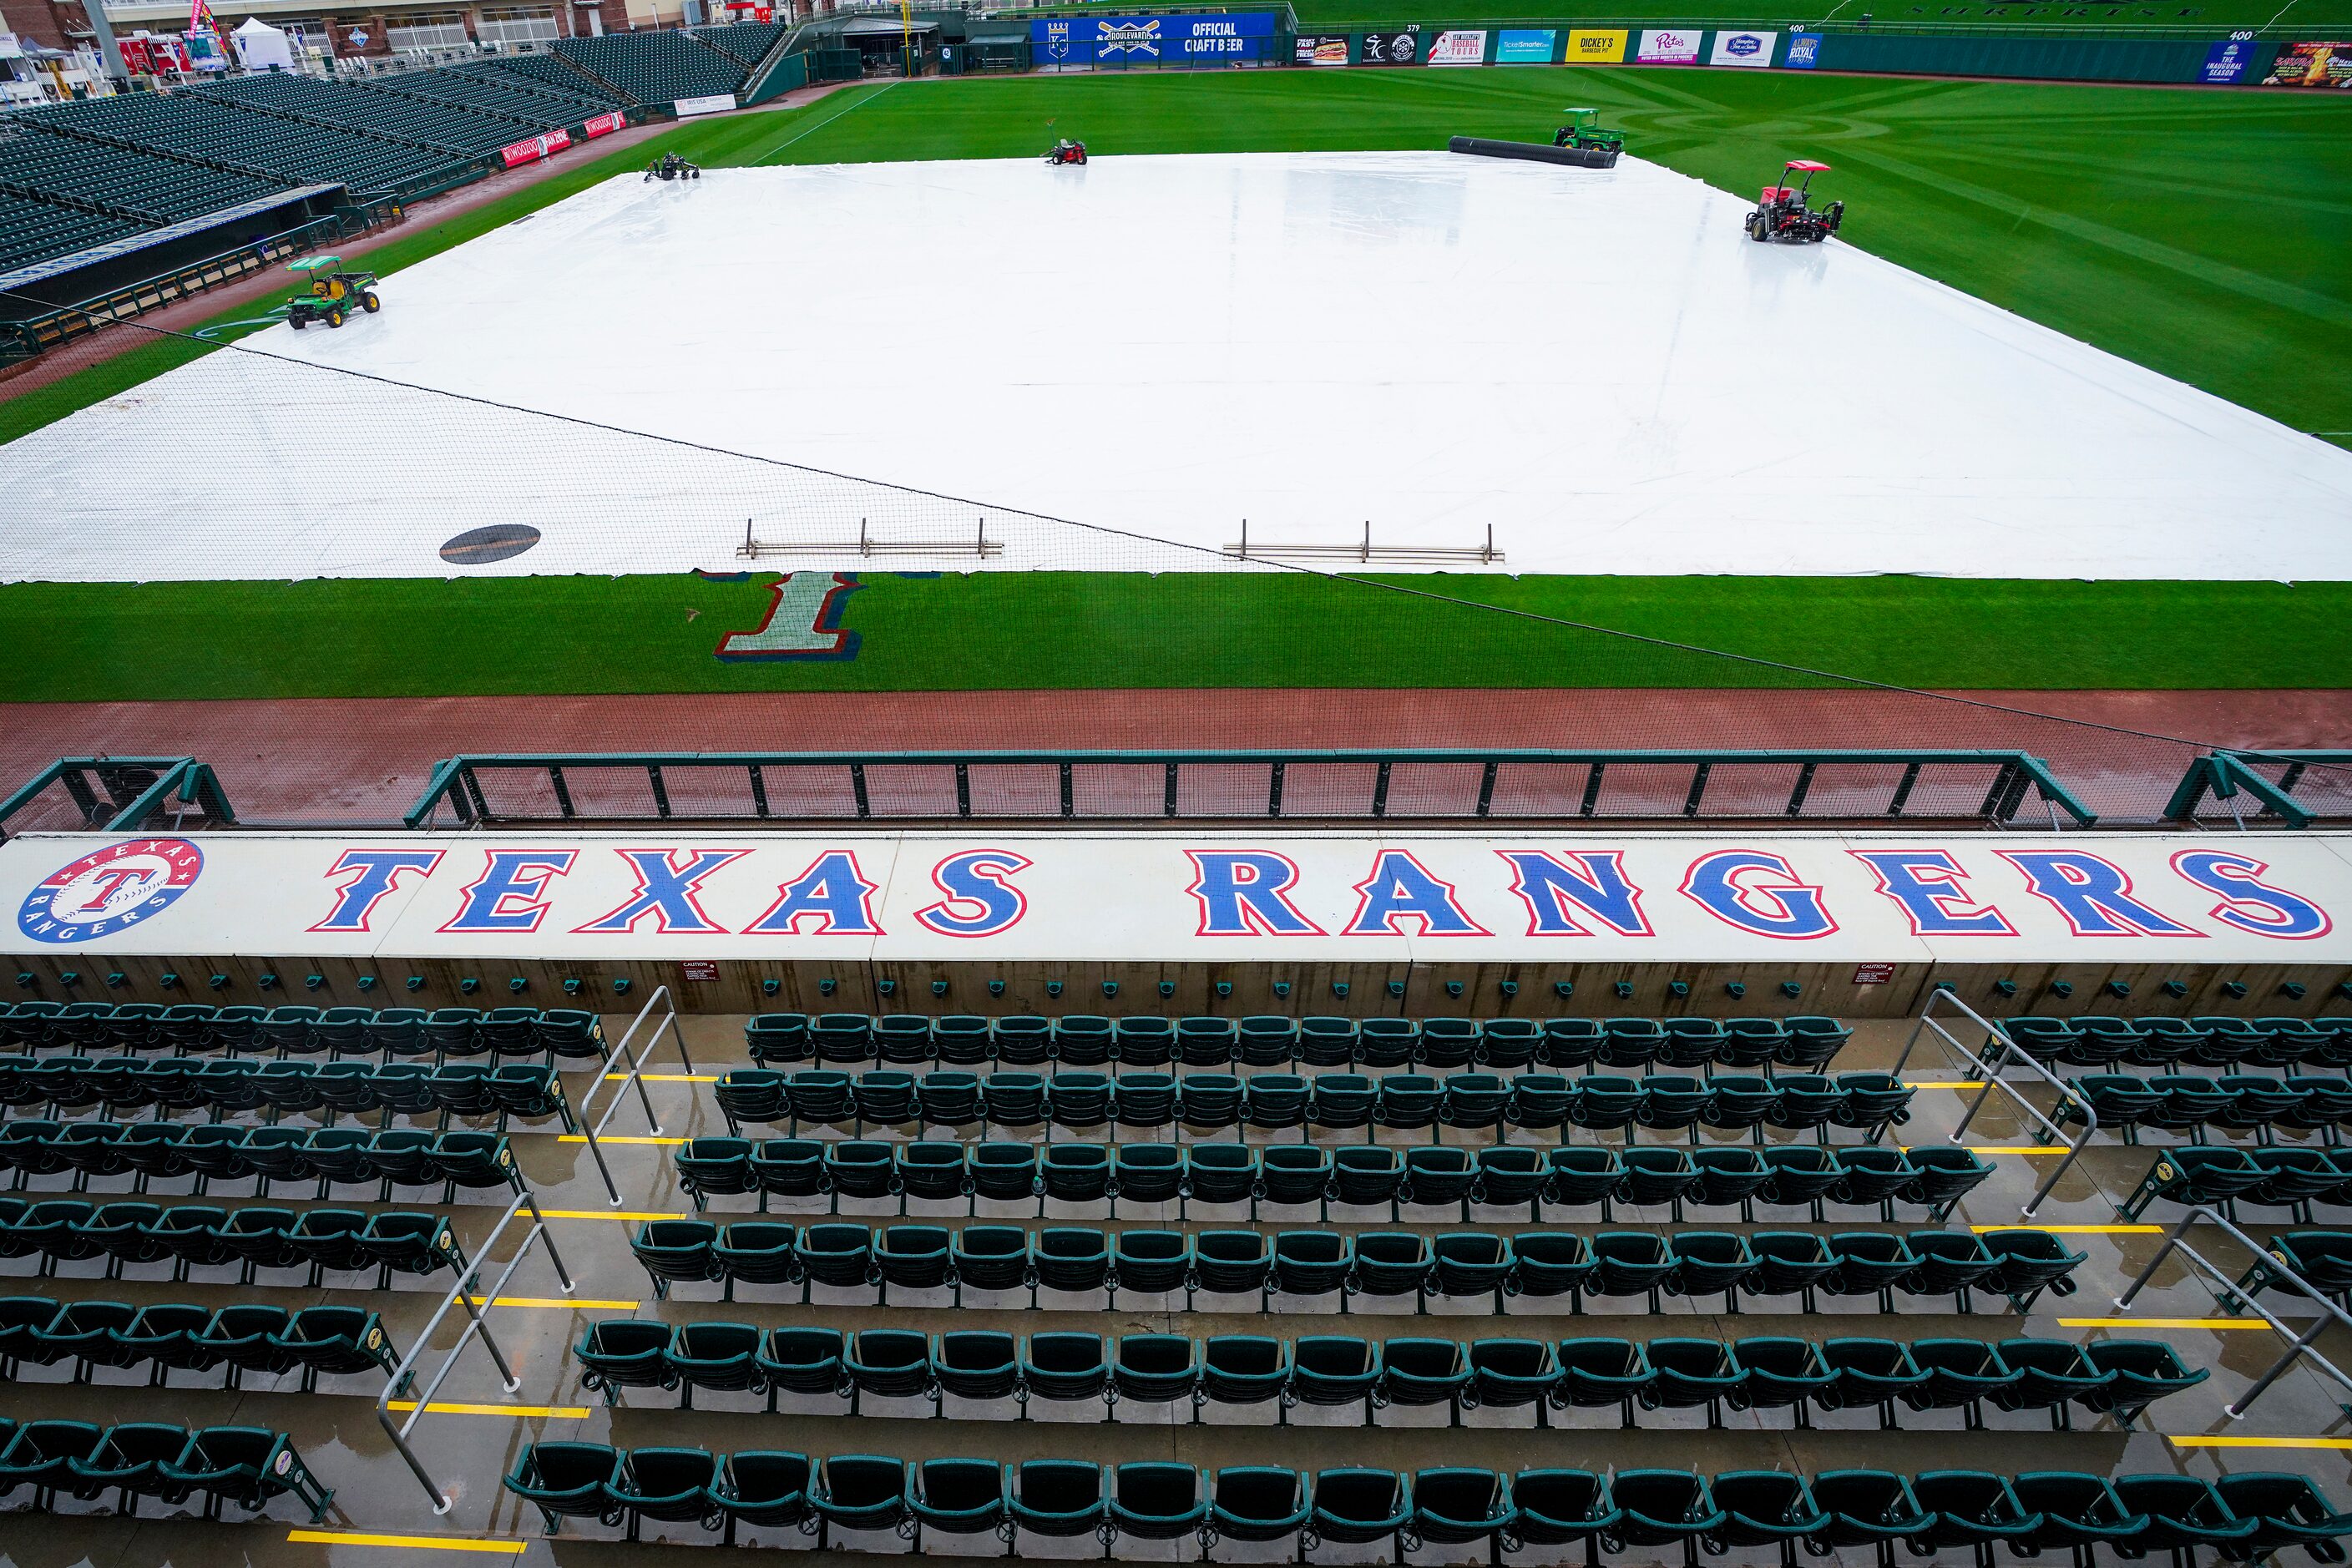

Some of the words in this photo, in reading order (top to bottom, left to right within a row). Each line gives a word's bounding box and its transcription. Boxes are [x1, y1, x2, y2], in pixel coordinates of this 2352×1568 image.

[1192, 23, 1236, 36] OFFICIAL
[2229, 31, 2253, 40] 400
[1185, 39, 1216, 52] CRAFT
[1581, 38, 1613, 48] DICKEY'S
[1657, 33, 1684, 49] Rito's
[1792, 38, 1818, 48] ALWAYS
[1788, 48, 1813, 58] ROYAL
[590, 117, 611, 130] WOOZOO
[511, 139, 538, 157] WOOZOO
[545, 135, 554, 147] FAN
[82, 841, 197, 867] TEXAS
[81, 868, 158, 913] T
[305, 848, 1034, 938] TEXAS
[1182, 848, 2333, 941] RANGERS
[26, 895, 167, 940] RANGERS
